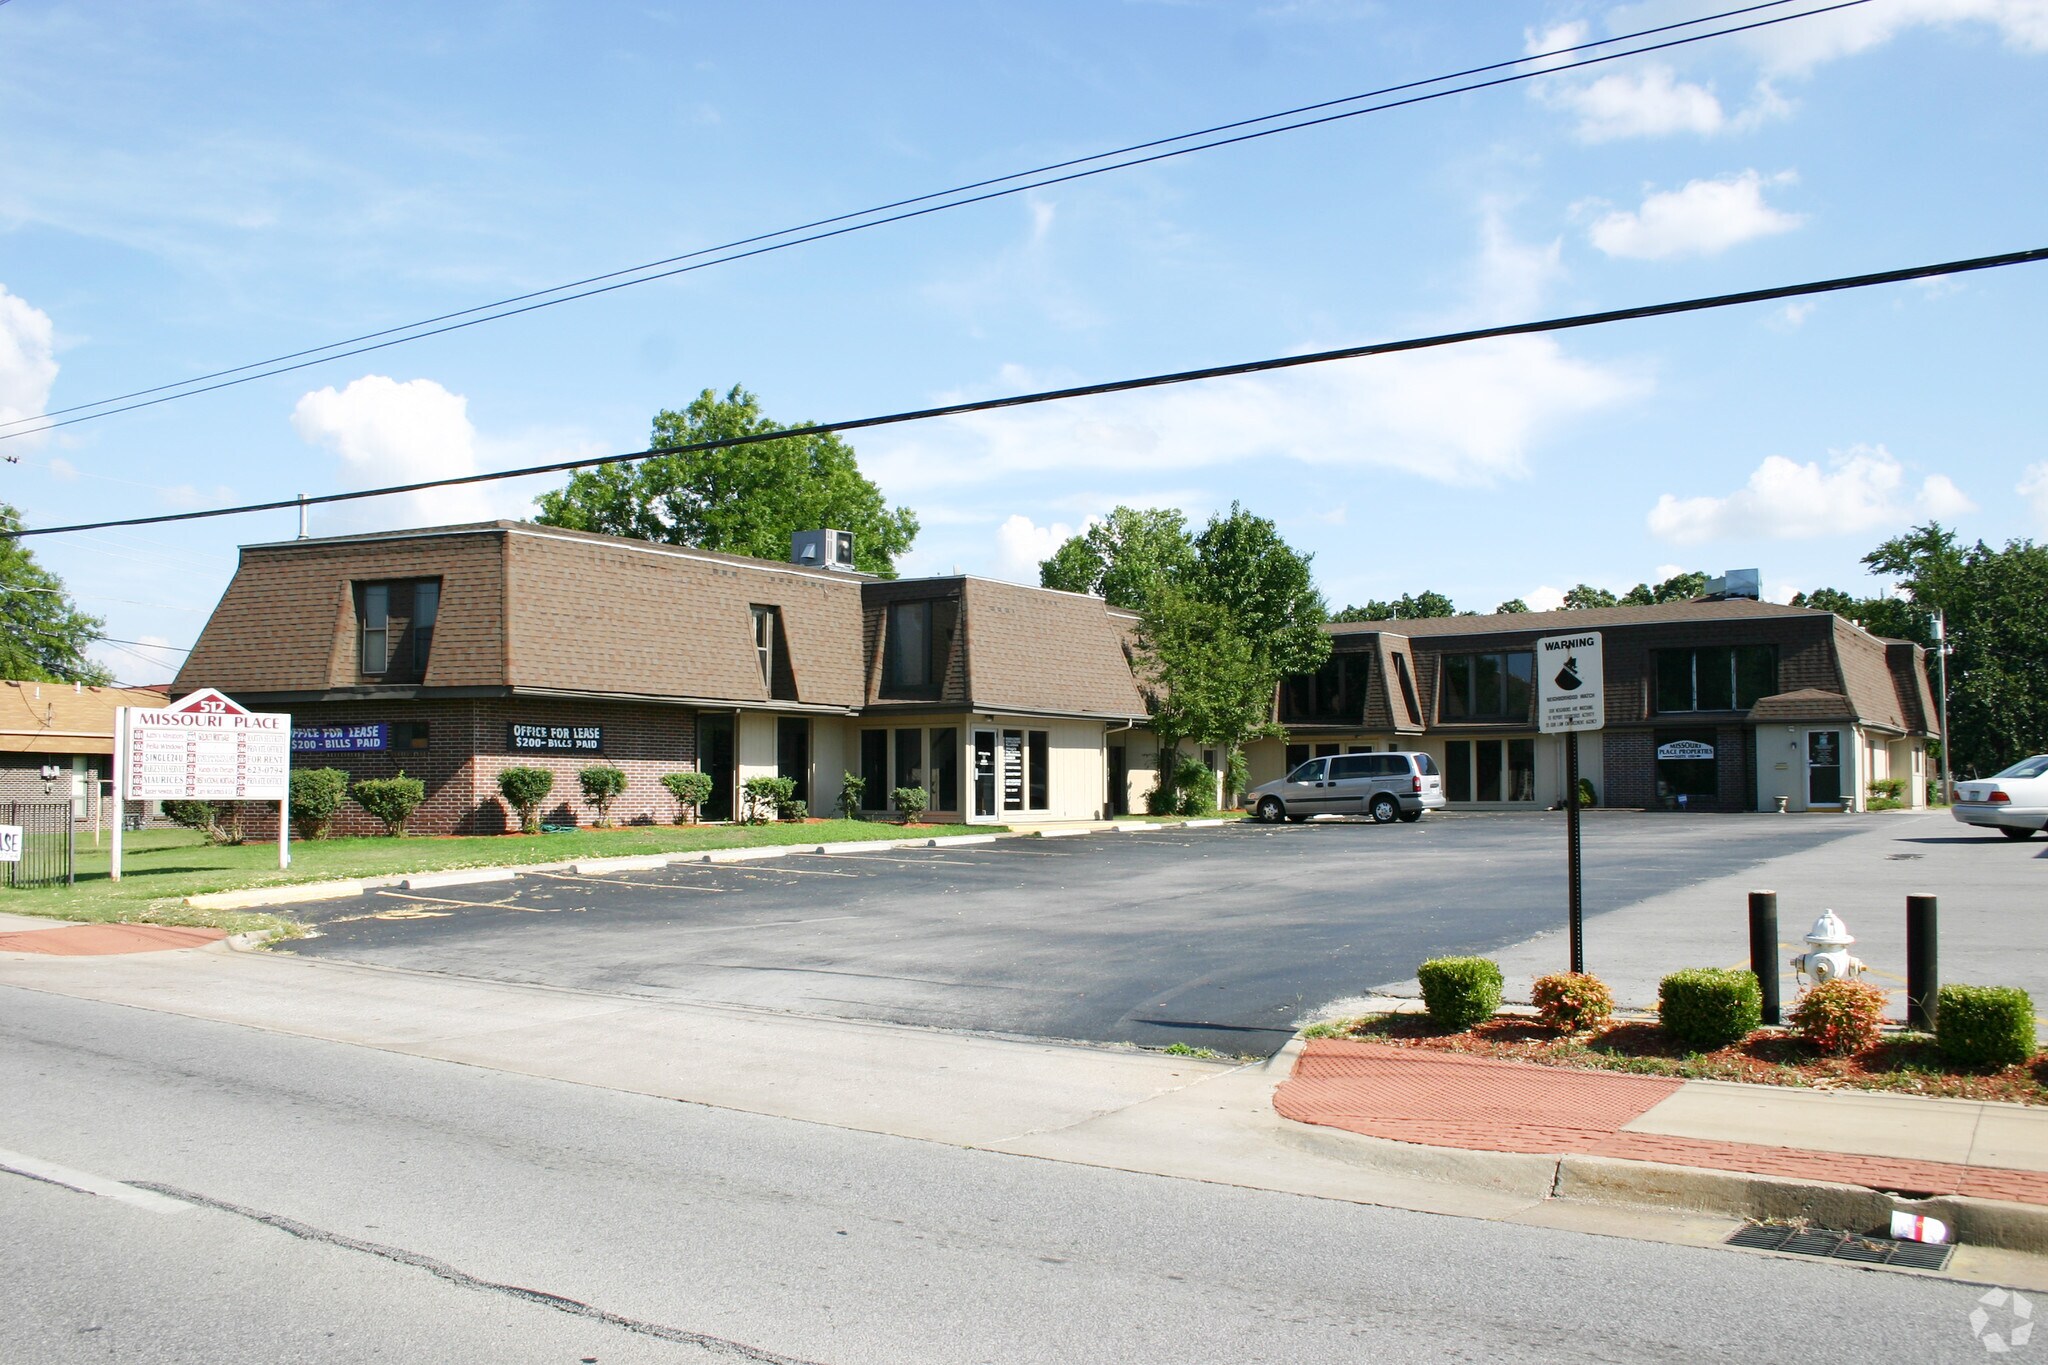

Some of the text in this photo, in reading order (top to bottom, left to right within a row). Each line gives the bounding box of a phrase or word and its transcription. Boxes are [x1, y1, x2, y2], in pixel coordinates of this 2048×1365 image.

[1545, 637, 1594, 651] WARNING
[200, 700, 226, 713] 512
[139, 713, 280, 729] MISSOURI PLACE
[291, 725, 379, 738] FFICE FOR LEASE
[513, 724, 600, 739] OFFICE FOR LEASE
[291, 740, 316, 749] $200
[325, 739, 351, 748] BILLS
[356, 738, 380, 748] PAID
[576, 740, 597, 749] PAID
[143, 776, 184, 784] MAURICES
